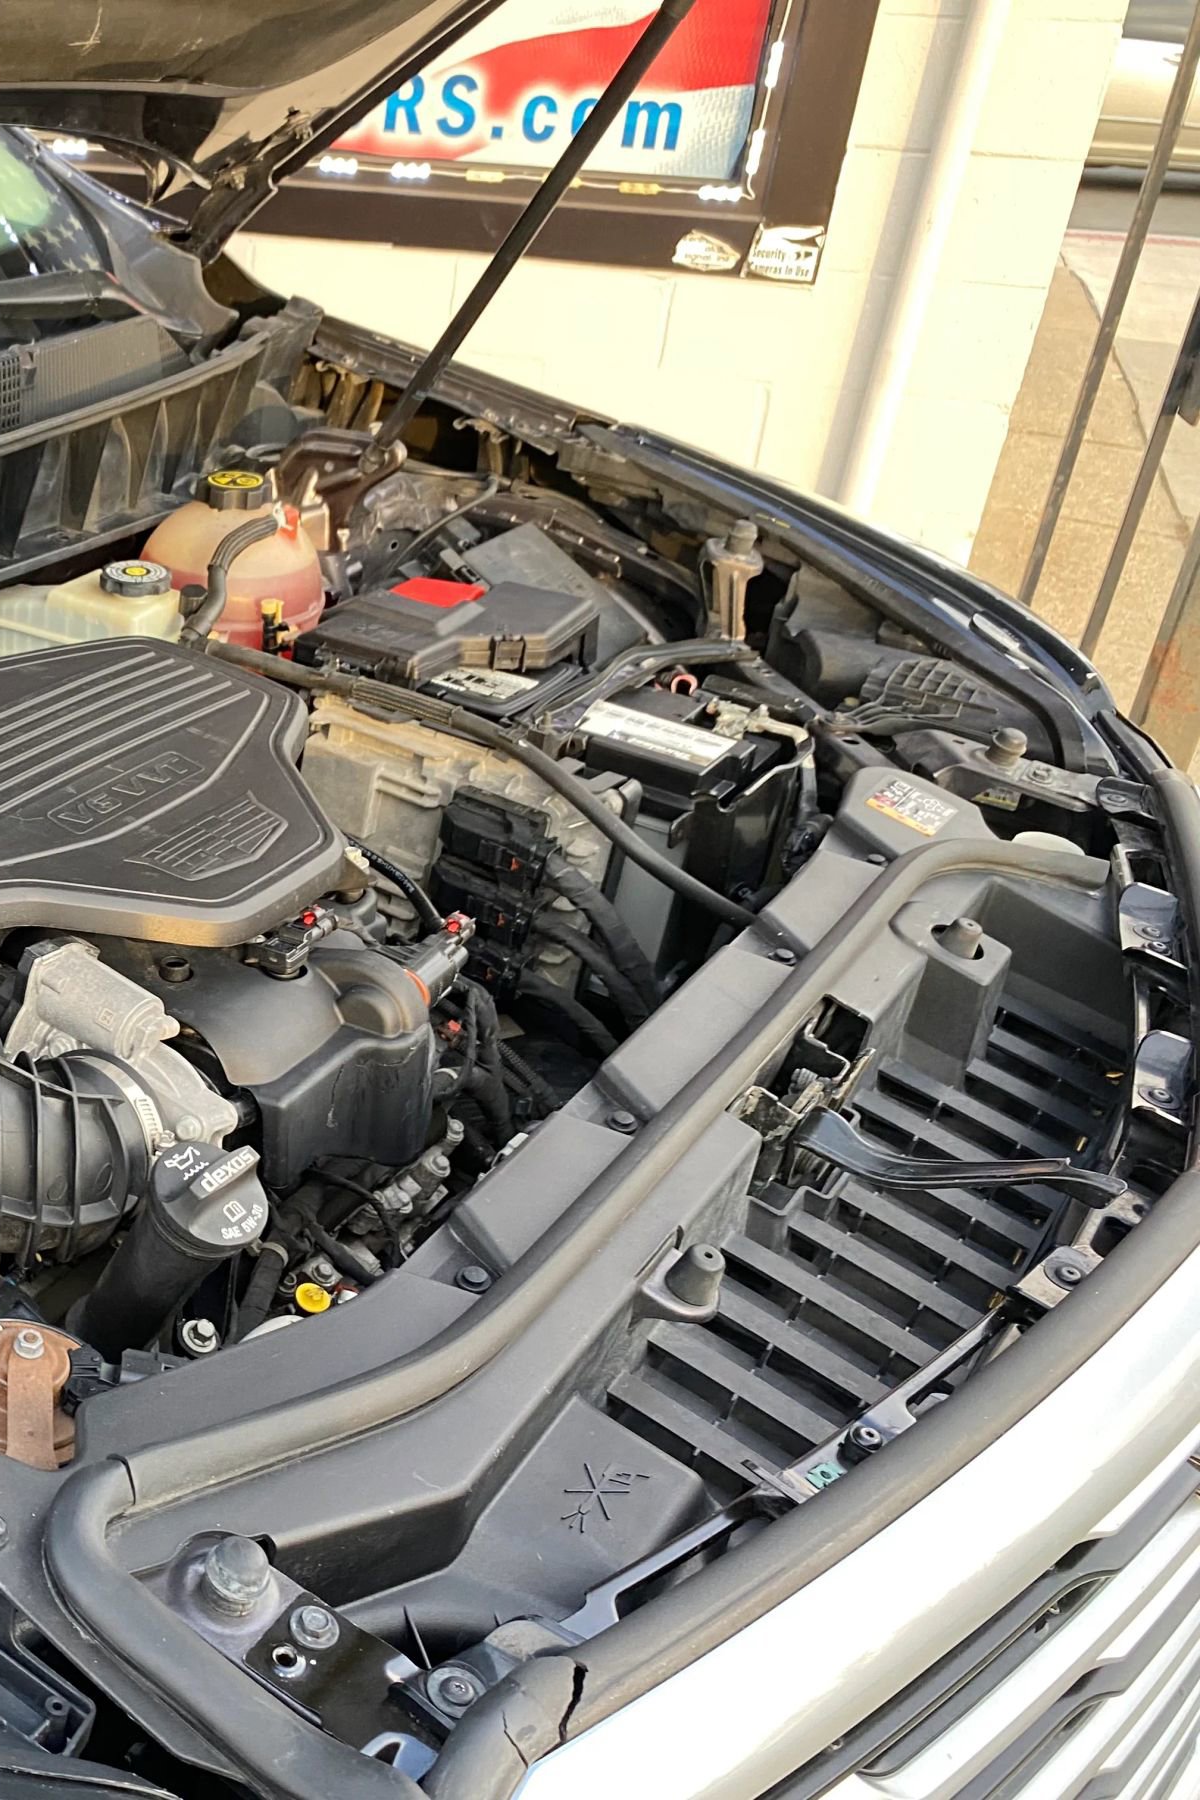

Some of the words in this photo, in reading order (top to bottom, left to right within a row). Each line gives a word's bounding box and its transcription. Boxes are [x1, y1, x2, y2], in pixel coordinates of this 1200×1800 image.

[752, 248, 786, 262] Security
[111, 757, 189, 796] VVT
[200, 1149, 255, 1192] dexos
[221, 1226, 243, 1240] SAE
[241, 1204, 264, 1233] 5W-30
